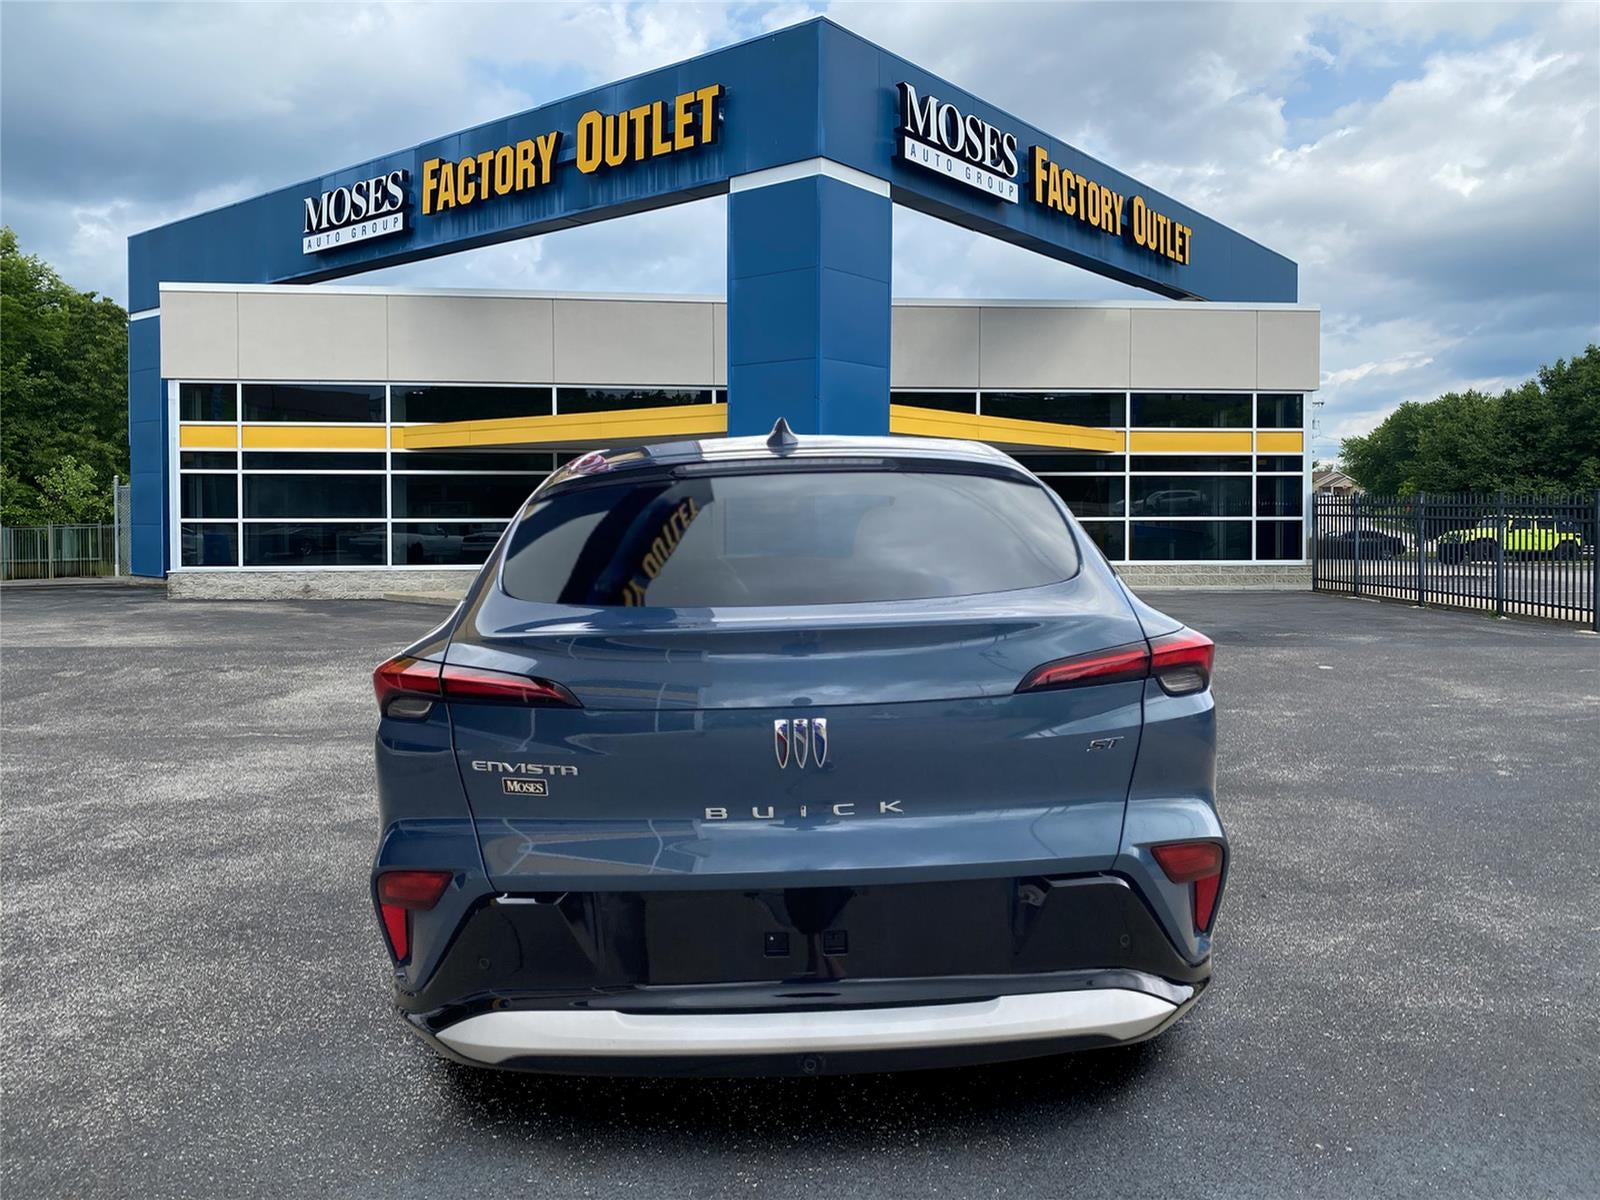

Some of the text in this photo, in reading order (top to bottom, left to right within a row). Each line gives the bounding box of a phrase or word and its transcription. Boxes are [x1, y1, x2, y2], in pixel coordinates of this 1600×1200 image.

[422, 84, 721, 216] FACTORY OUTLET
[904, 82, 1019, 179] MOSES
[909, 143, 1015, 197] AUTO GROUP
[303, 170, 404, 233] MOSES
[1034, 145, 1192, 266] FACTORY OUTLET
[307, 216, 399, 250] AUTO GROUP
[471, 760, 579, 776] ENVISTA
[506, 780, 544, 793] MOSES
[705, 800, 904, 820] BUICK
